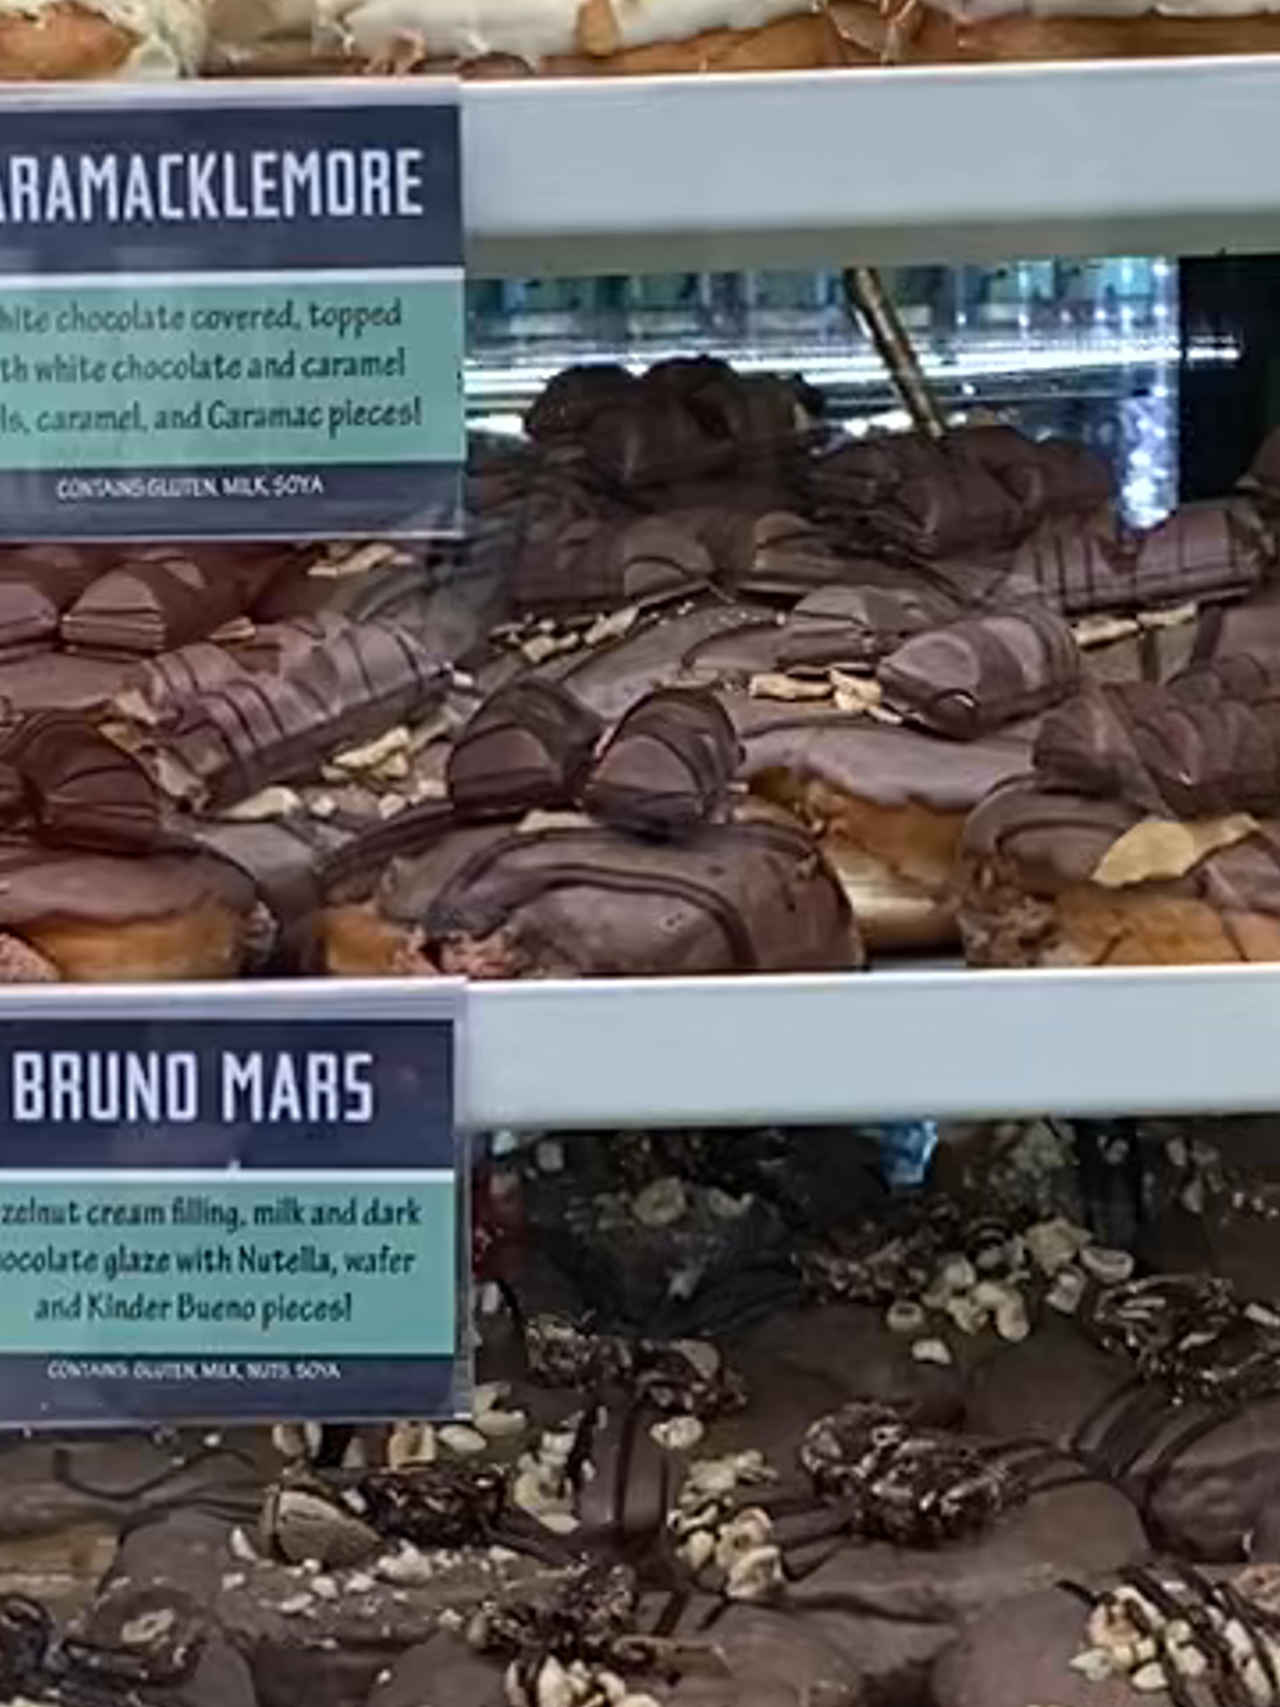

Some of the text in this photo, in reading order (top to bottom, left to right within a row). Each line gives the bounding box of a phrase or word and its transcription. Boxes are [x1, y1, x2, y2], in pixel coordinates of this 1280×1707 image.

[55, 299, 186, 332] chocolate
[190, 299, 302, 331] covered,
[307, 297, 403, 339] topped
[33, 354, 107, 383] white
[111, 351, 242, 382] chocolate
[246, 349, 296, 379] and
[300, 346, 406, 379] caramel
[35, 401, 149, 432] caramel,
[153, 400, 204, 429] and
[207, 400, 324, 430] Caramac
[328, 396, 422, 439] pieces!
[13, 1052, 373, 1122] BRUNO MARS
[85, 1204, 167, 1227] cream
[171, 1196, 248, 1235] filling,
[253, 1197, 306, 1225] milk
[309, 1197, 358, 1226] and
[361, 1197, 422, 1226] dark
[103, 1244, 171, 1281] glaze
[176, 1245, 233, 1273] with
[237, 1244, 338, 1277] Nutella,
[343, 1244, 417, 1274] wafer
[34, 1291, 353, 1331] and Kinder Bueno pieces!
